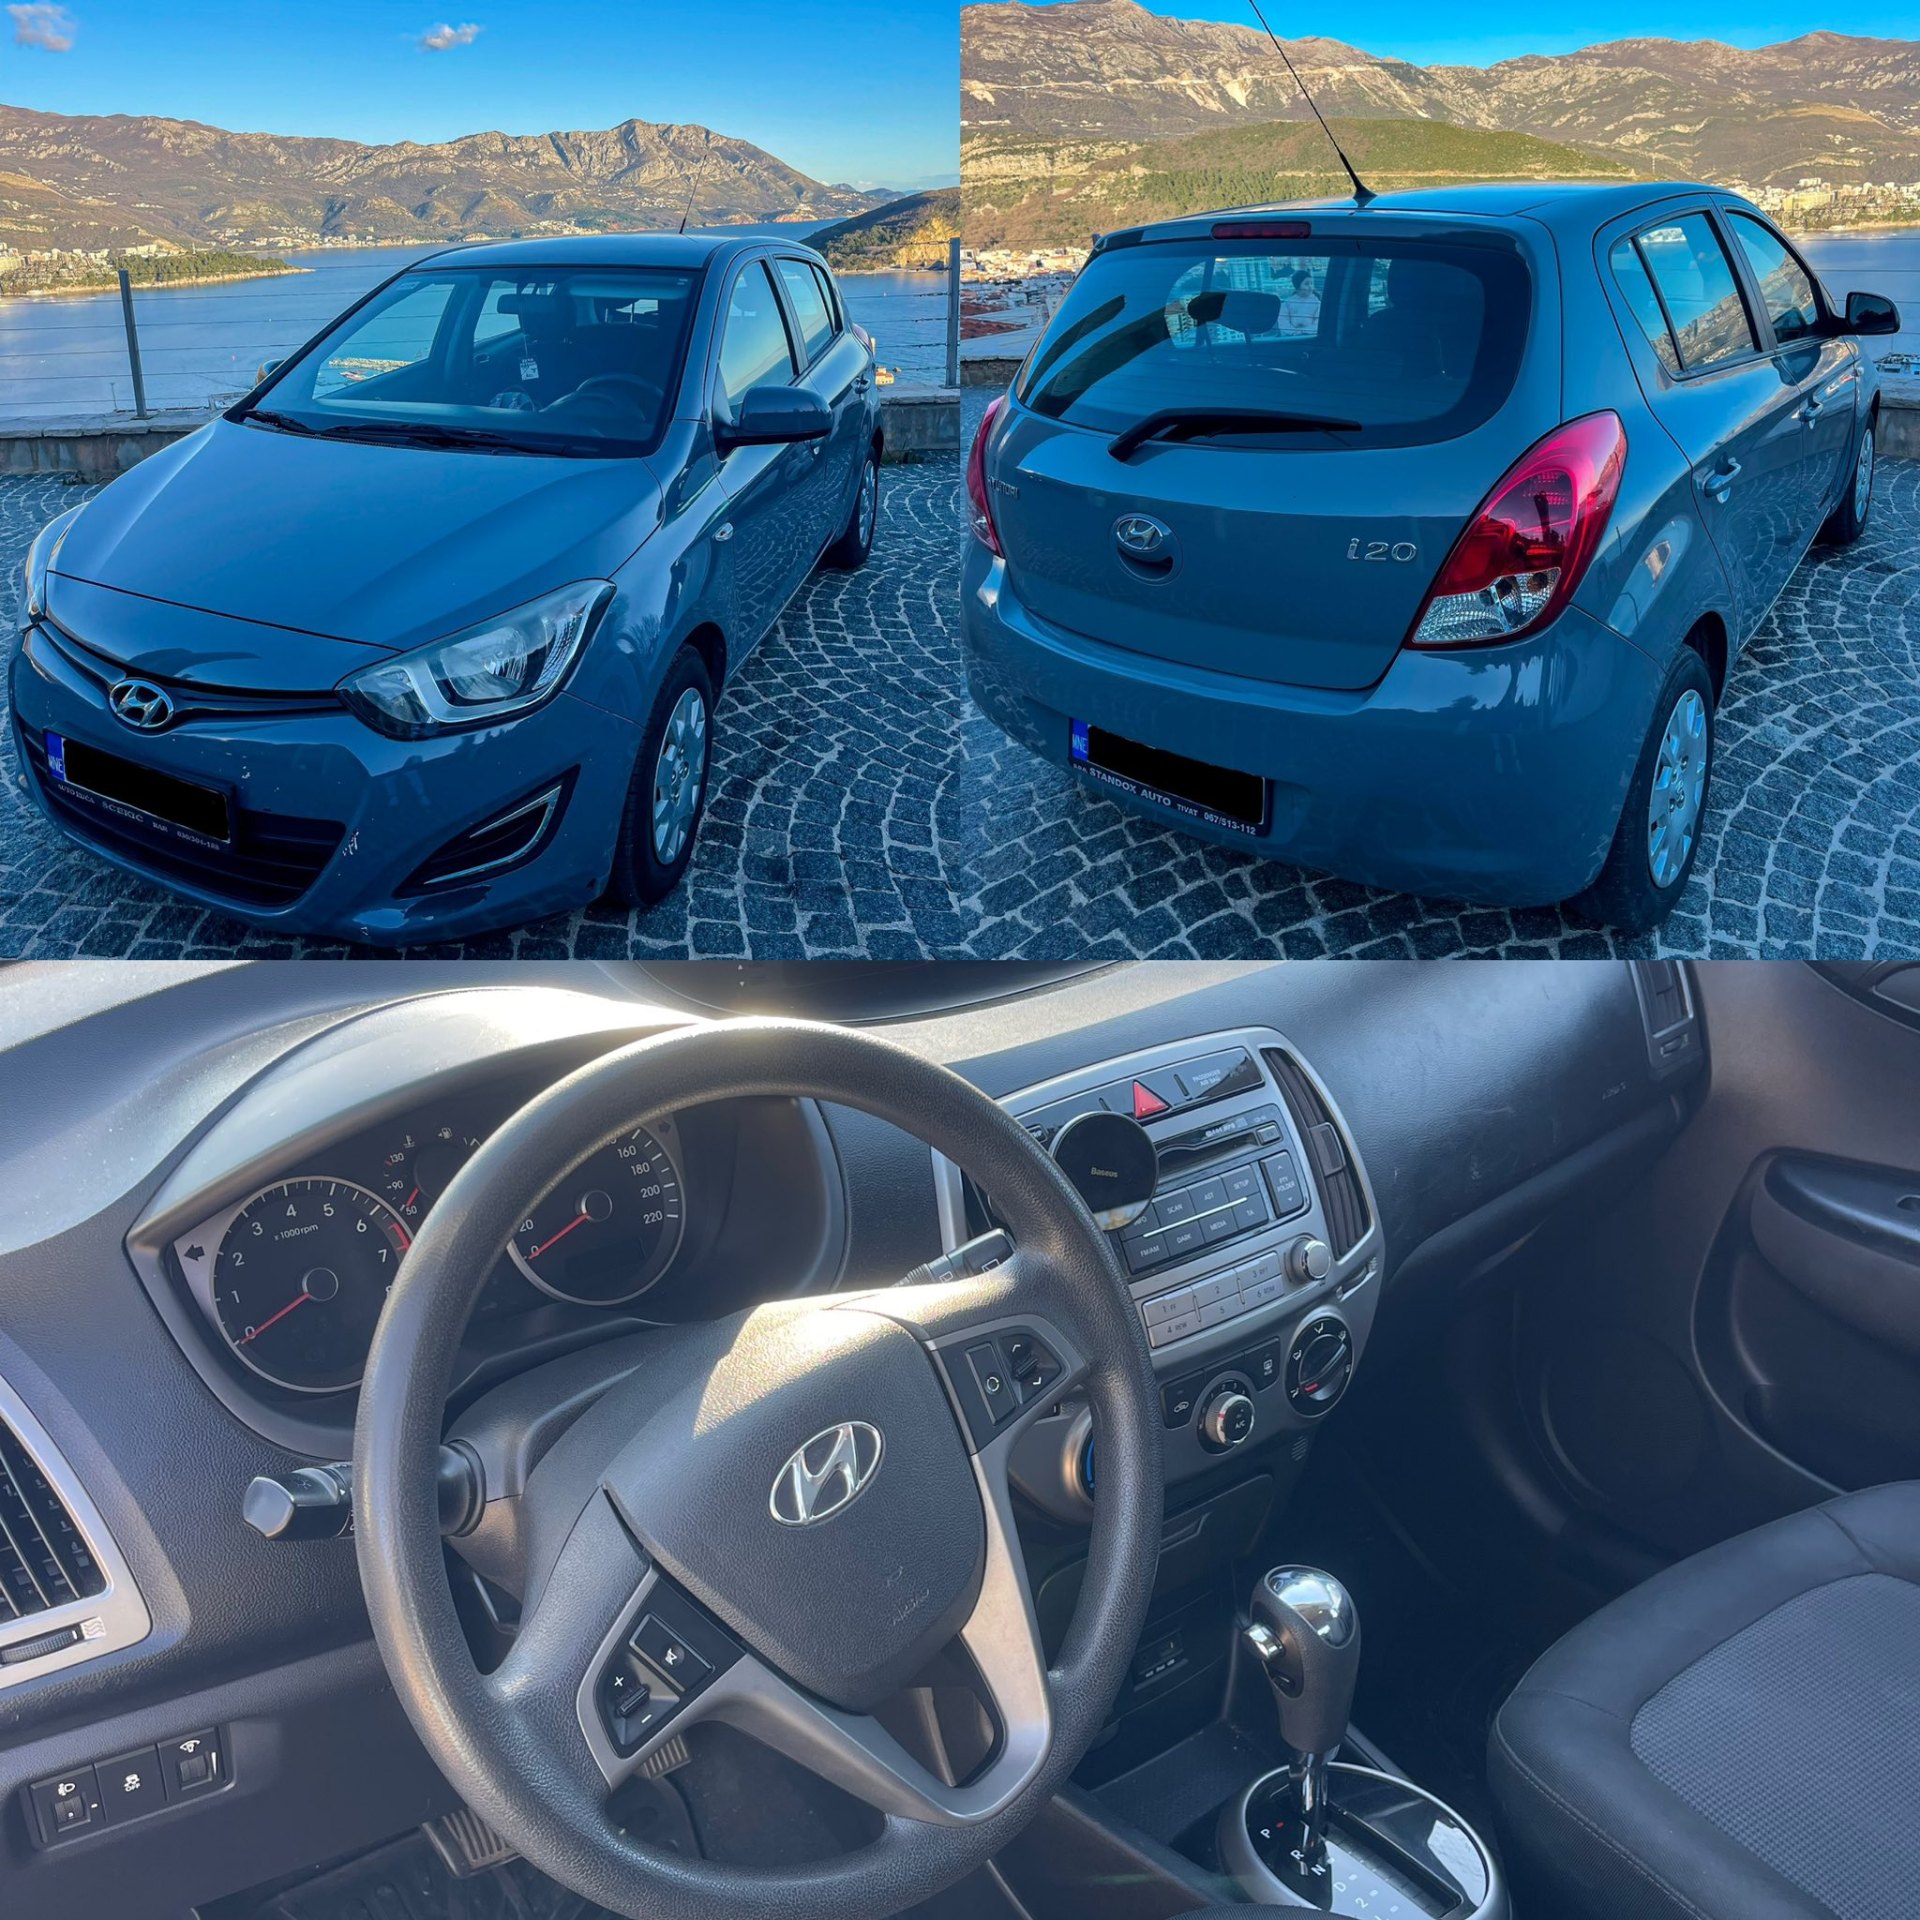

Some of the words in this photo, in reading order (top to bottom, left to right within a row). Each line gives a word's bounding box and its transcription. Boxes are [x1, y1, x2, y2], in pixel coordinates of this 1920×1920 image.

[1346, 537, 1417, 561] i20
[1072, 733, 1088, 753] MNE
[1089, 767, 1137, 794] STANDOX
[1140, 789, 1171, 807] AUTO
[1177, 803, 1199, 817] TIVAT
[1203, 811, 1257, 836] 067/513-112
[390, 1152, 405, 1163] 130
[617, 1145, 637, 1159] 160
[631, 1162, 650, 1176] 180
[1090, 1166, 1118, 1178] Baseus
[392, 1180, 404, 1190] 90
[640, 1184, 661, 1198] 200
[1233, 1179, 1249, 1190] SETUP
[286, 1204, 297, 1217] 4
[323, 1203, 334, 1217] 5
[1166, 1203, 1183, 1214] SCAN
[643, 1210, 662, 1224] 220
[252, 1222, 263, 1236] 3
[356, 1219, 367, 1233] 6
[1209, 1220, 1227, 1231] MEDIA
[1176, 1232, 1192, 1244] DARK
[232, 1252, 245, 1266] 2
[378, 1249, 387, 1263] 7
[1252, 1270, 1257, 1278] 3
[1214, 1285, 1220, 1294] 2
[1257, 1289, 1262, 1298] 6
[231, 1290, 240, 1304] 1
[1220, 1305, 1225, 1314] 5
[1167, 1325, 1173, 1334] 4
[1235, 1420, 1246, 1430] A/C
[124, 1782, 141, 1792] OFF
[1260, 1828, 1271, 1839] P
[1290, 1849, 1305, 1860] R
[1311, 1864, 1326, 1876] N
[1332, 1881, 1347, 1893] D
[1355, 1897, 1369, 1909] 2
